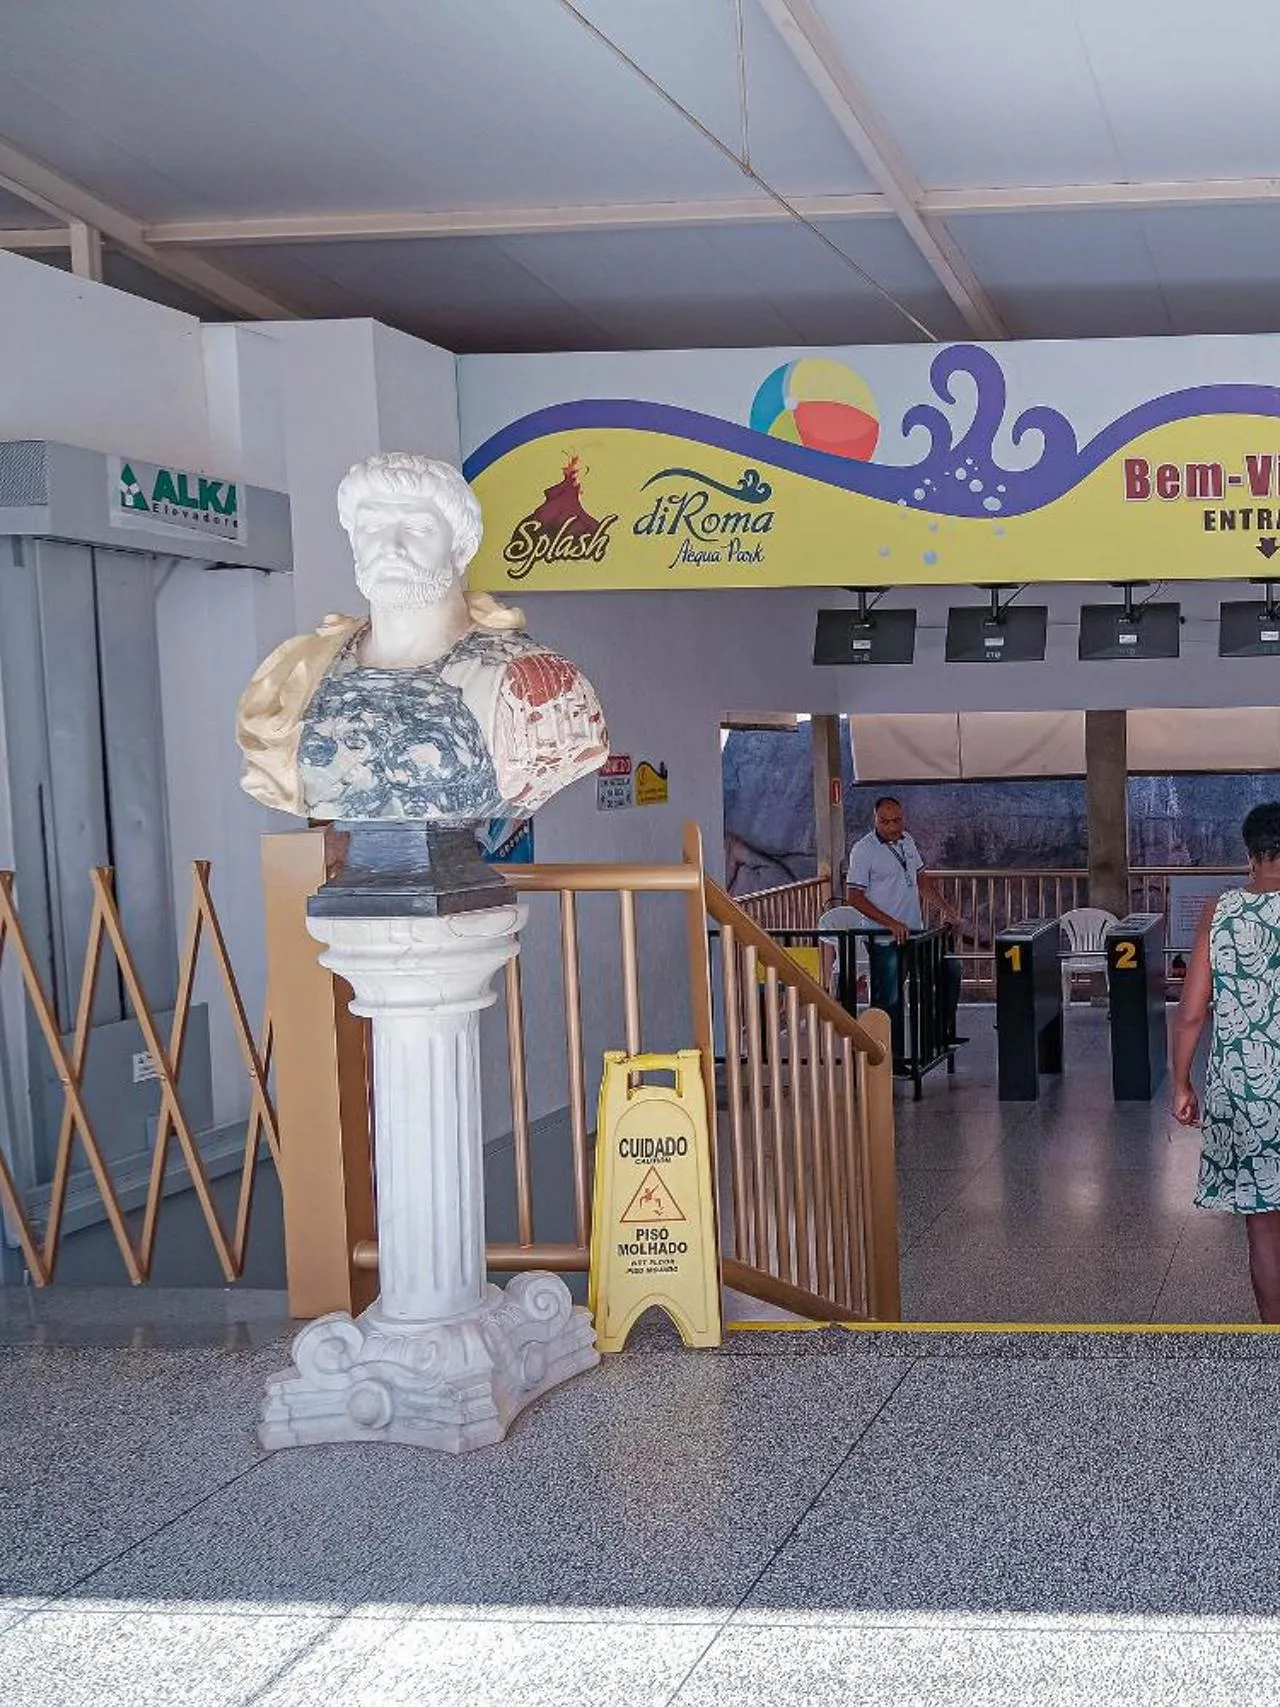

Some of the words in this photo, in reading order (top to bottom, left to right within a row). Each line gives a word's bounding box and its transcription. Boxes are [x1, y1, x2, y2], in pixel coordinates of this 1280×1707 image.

[503, 513, 620, 579] Splash
[720, 538, 765, 563] Park
[1004, 945, 1022, 972] 1
[1115, 941, 1138, 969] 2
[619, 1136, 688, 1158] CUIDADO
[636, 1228, 669, 1241] PISO
[617, 1242, 688, 1256] MOLHADO
